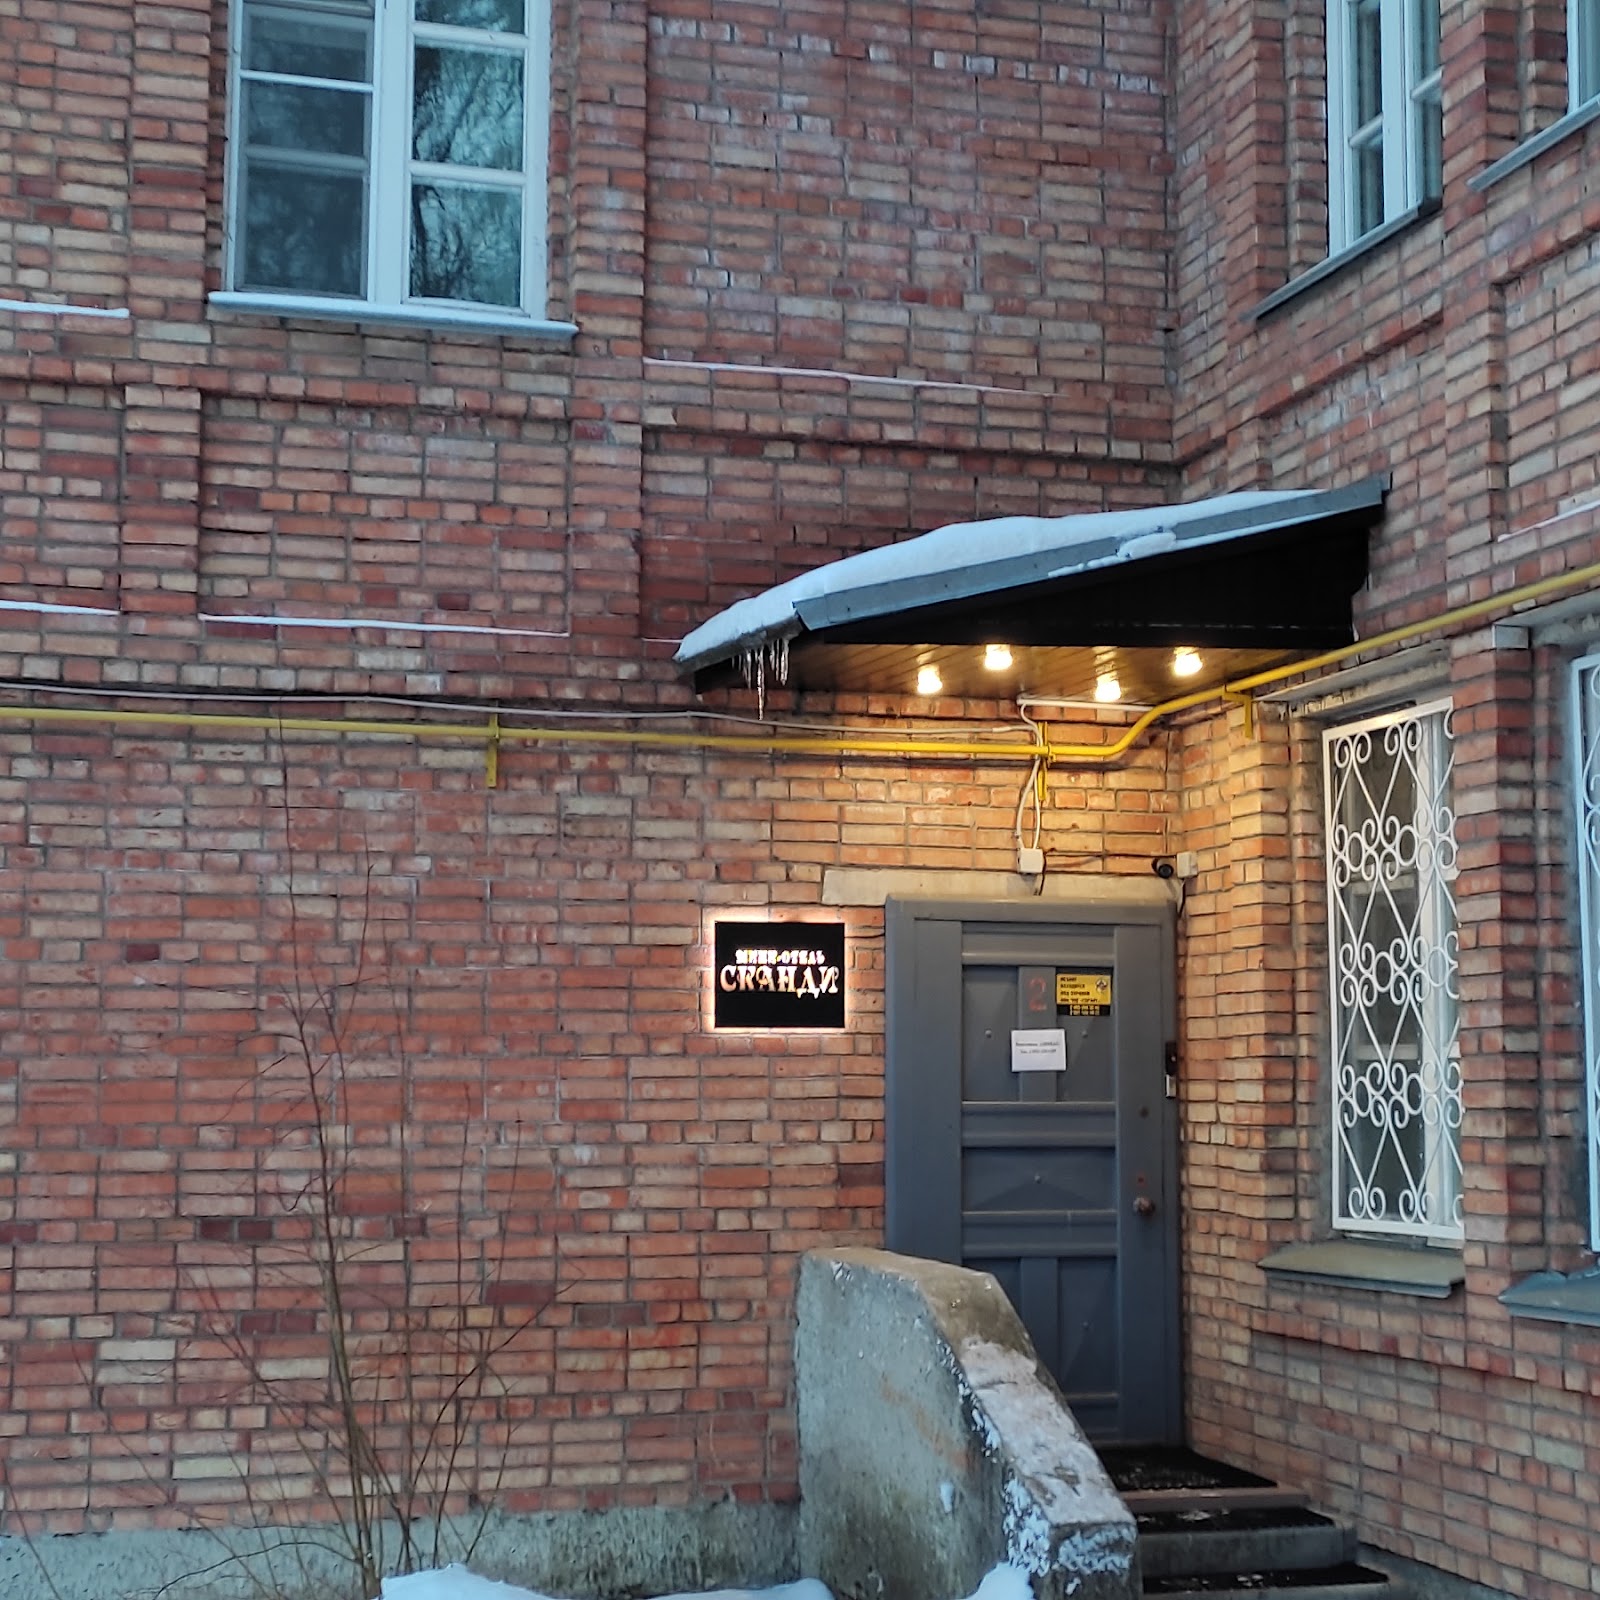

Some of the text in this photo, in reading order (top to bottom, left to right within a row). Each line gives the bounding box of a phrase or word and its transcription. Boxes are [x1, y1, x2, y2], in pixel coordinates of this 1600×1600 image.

[735, 949, 825, 965] МИНИ-ОТЕЛЬ
[720, 964, 840, 999] СКАНДИ
[1029, 977, 1047, 1012] 2
